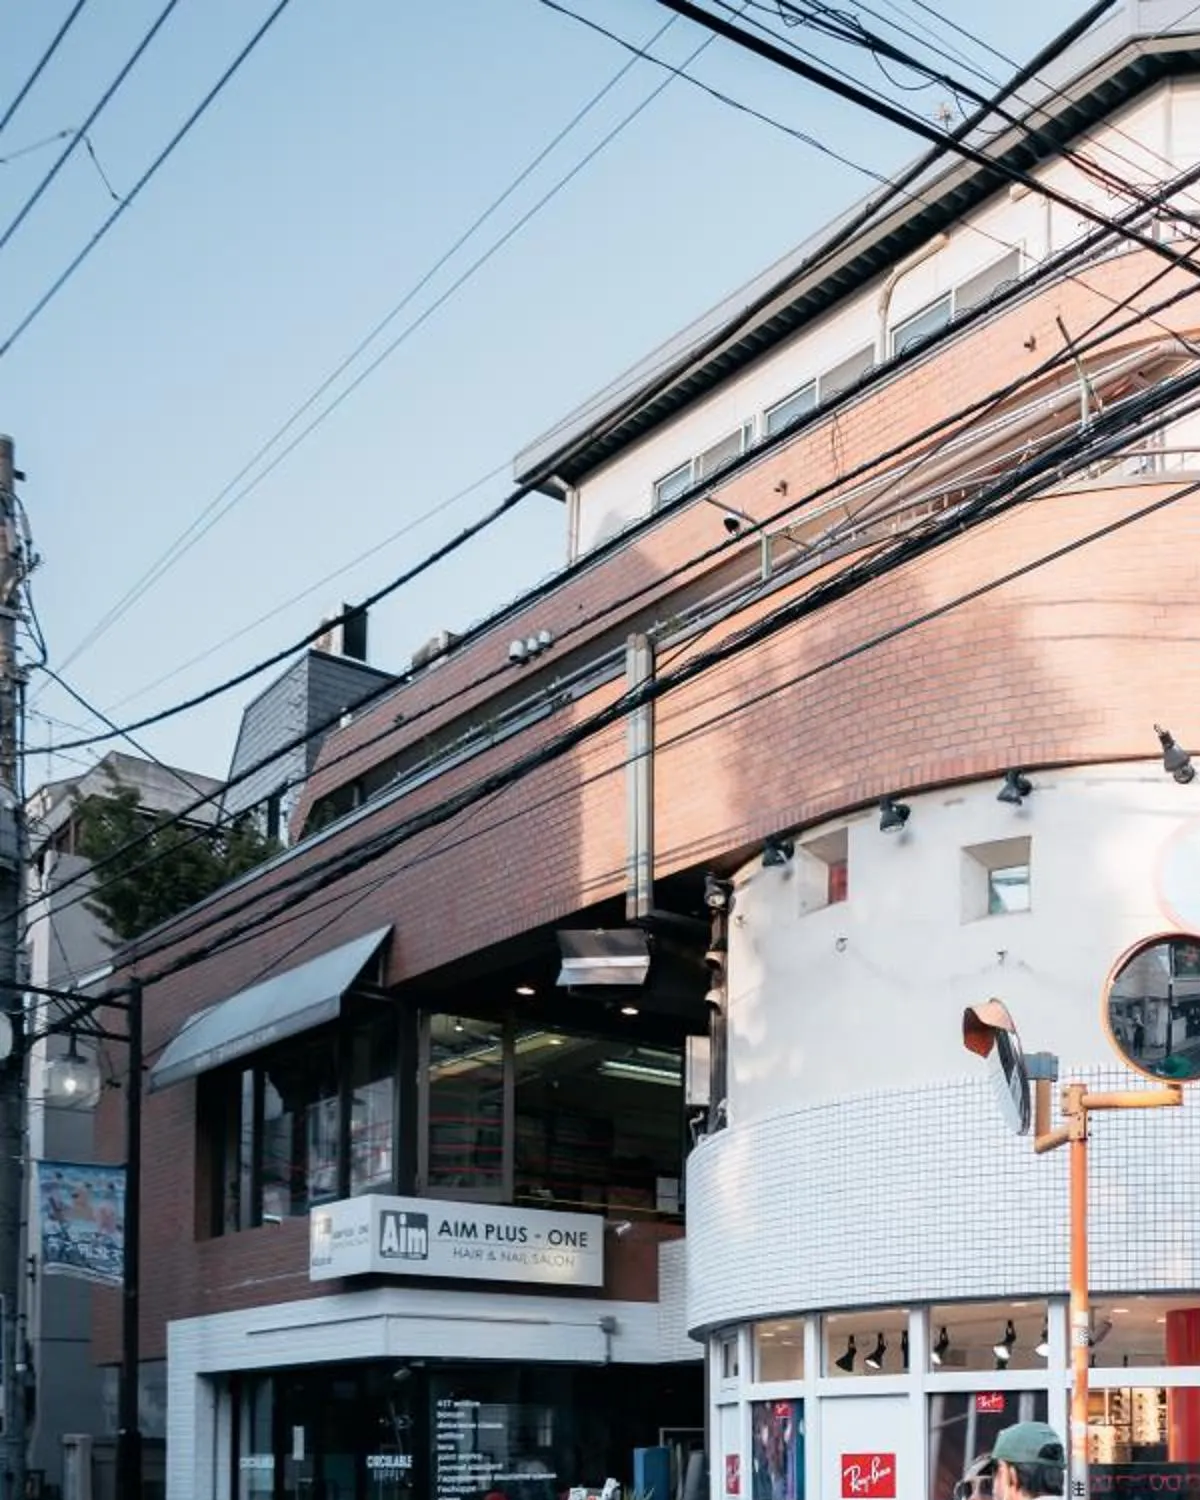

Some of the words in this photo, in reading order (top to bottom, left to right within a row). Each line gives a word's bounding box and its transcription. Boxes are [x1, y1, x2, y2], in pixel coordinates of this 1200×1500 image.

[382, 1214, 427, 1254] Aim
[438, 1219, 478, 1239] AIM
[485, 1223, 528, 1243] PLUS
[547, 1229, 589, 1248] ONE
[453, 1247, 483, 1261] HAIR
[487, 1250, 497, 1261] &
[501, 1250, 529, 1264] NAIL
[532, 1254, 576, 1268] SALON
[843, 1456, 891, 1493] Ray-Ban
